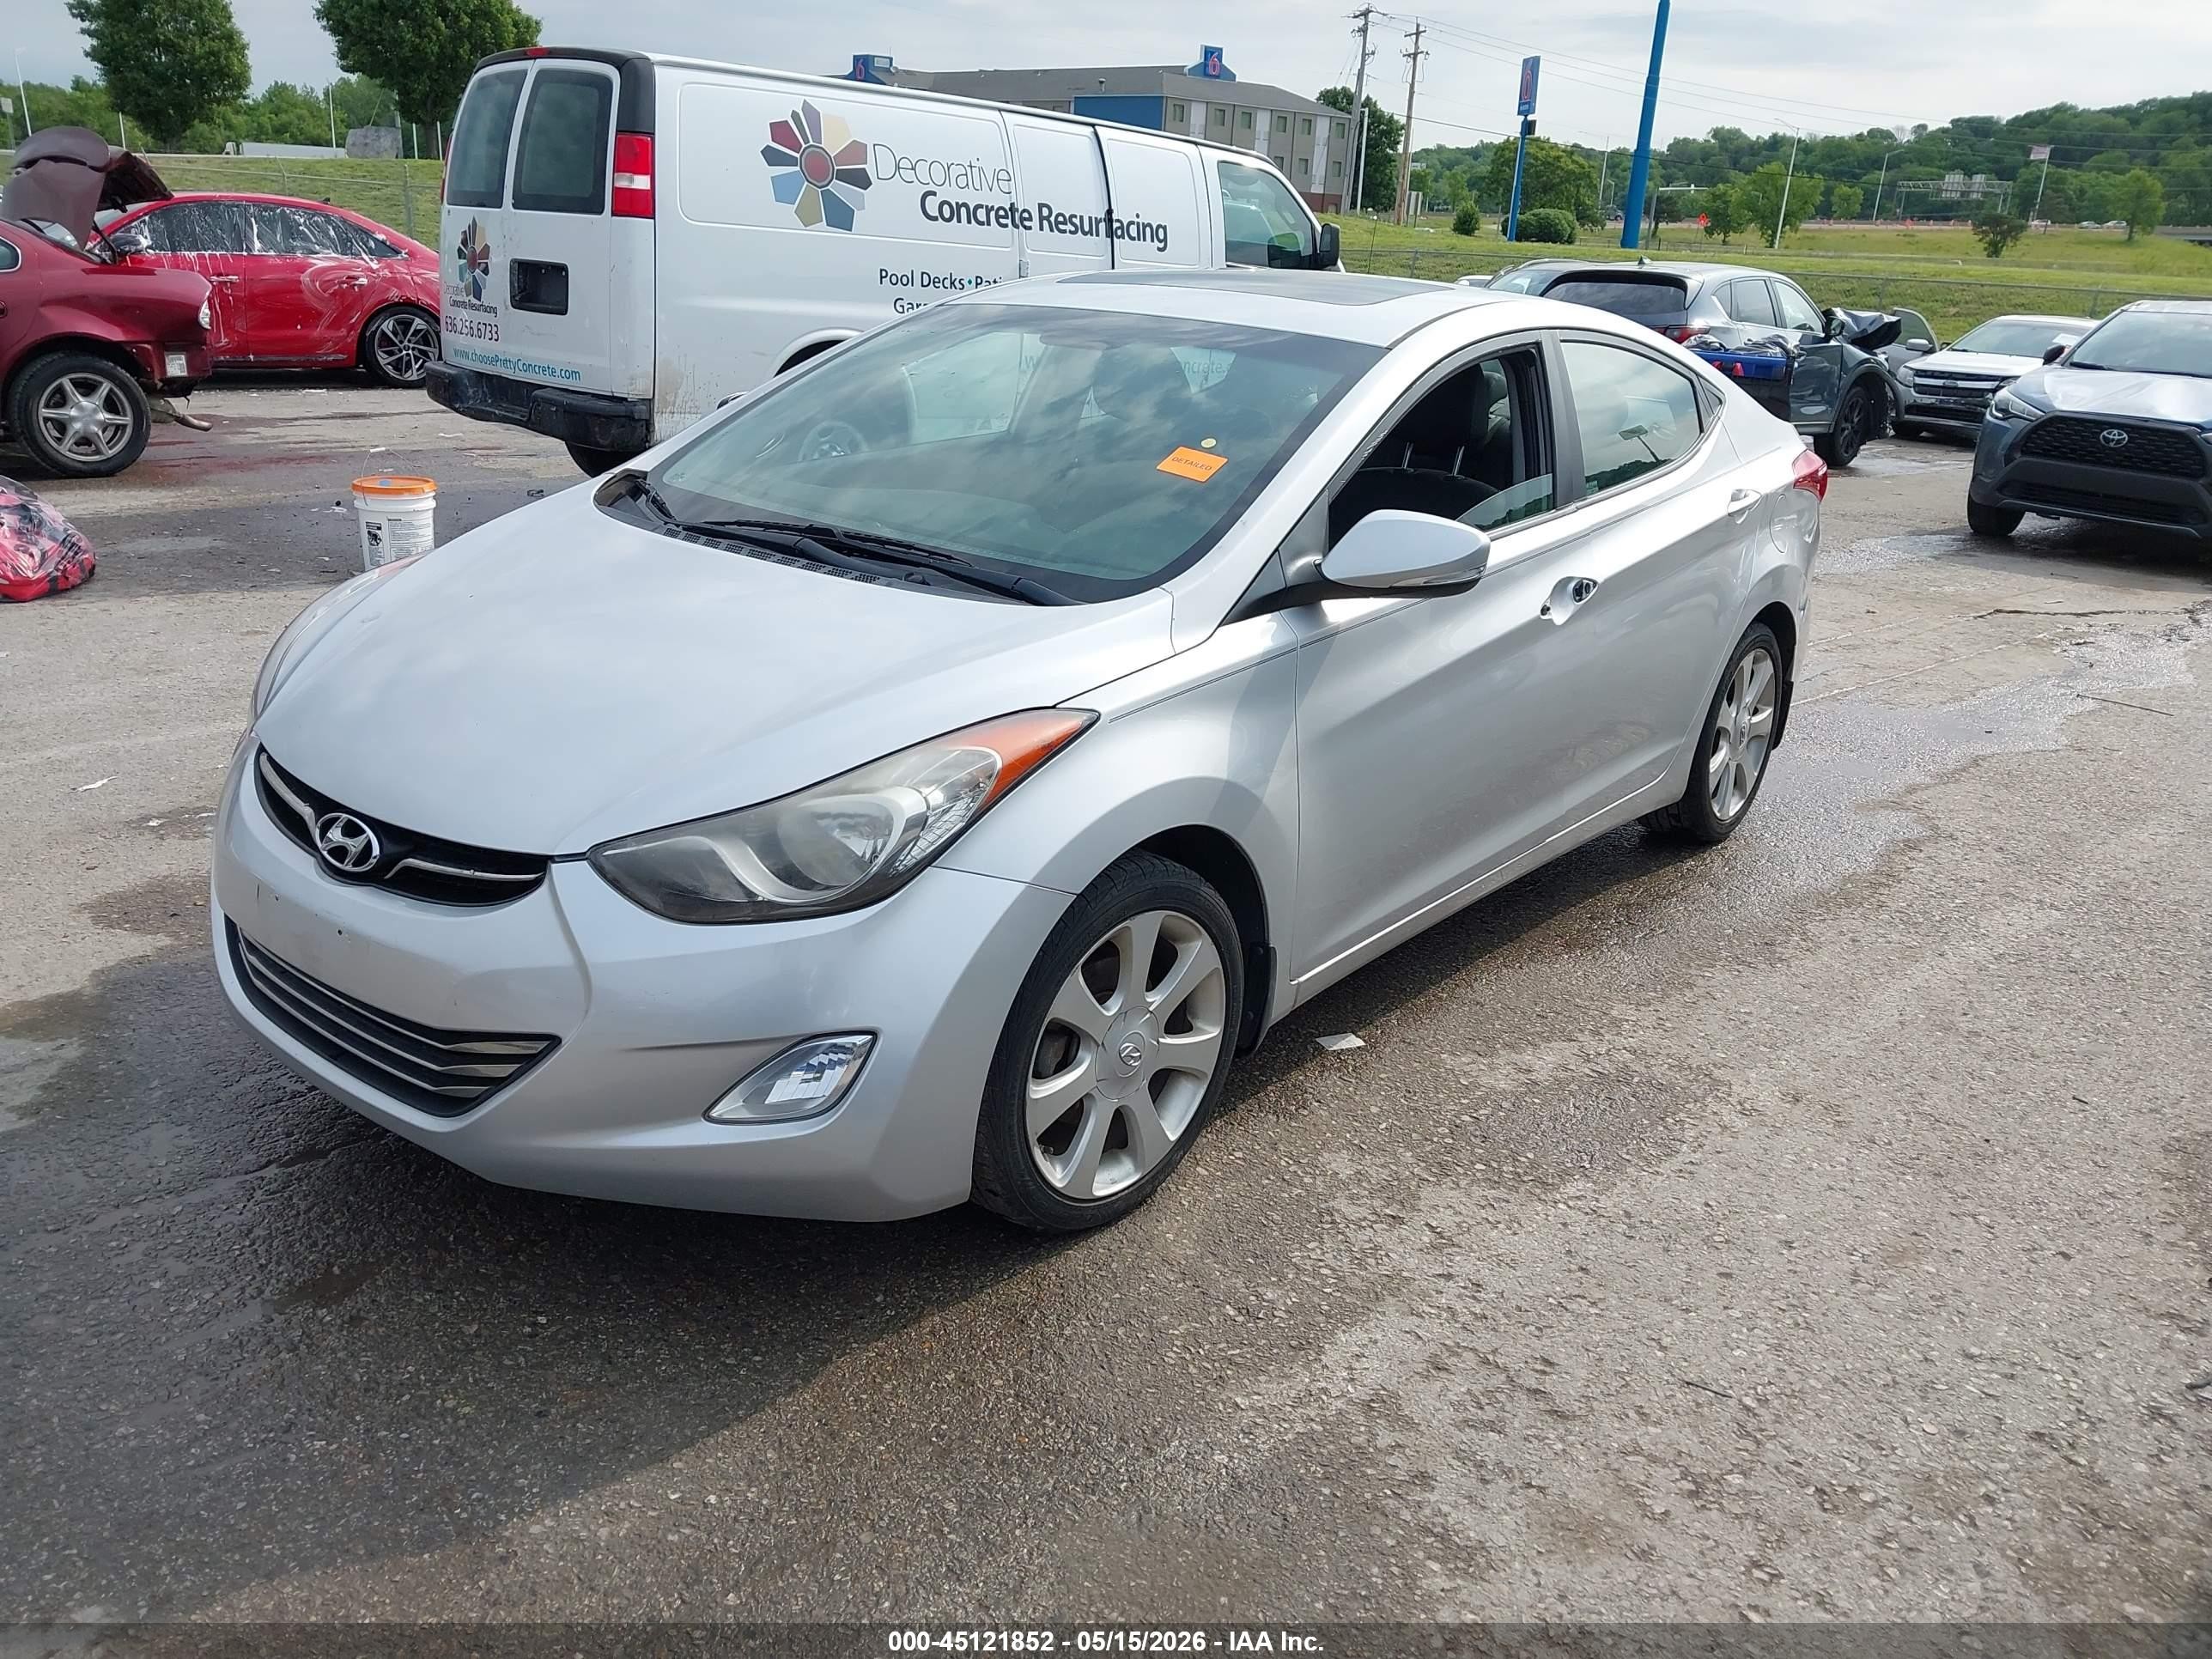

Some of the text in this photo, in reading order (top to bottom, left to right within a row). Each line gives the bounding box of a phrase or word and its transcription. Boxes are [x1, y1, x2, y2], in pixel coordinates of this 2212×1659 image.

[855, 58, 866, 80] 6
[1208, 52, 1220, 76] 6
[872, 143, 1012, 195] Decorative
[920, 190, 1169, 252] Concrete Resurfacing
[878, 268, 915, 288] Pool
[921, 271, 966, 291] Decks
[445, 315, 500, 342] 636.256.6733
[1171, 456, 1212, 471] DETAILED
